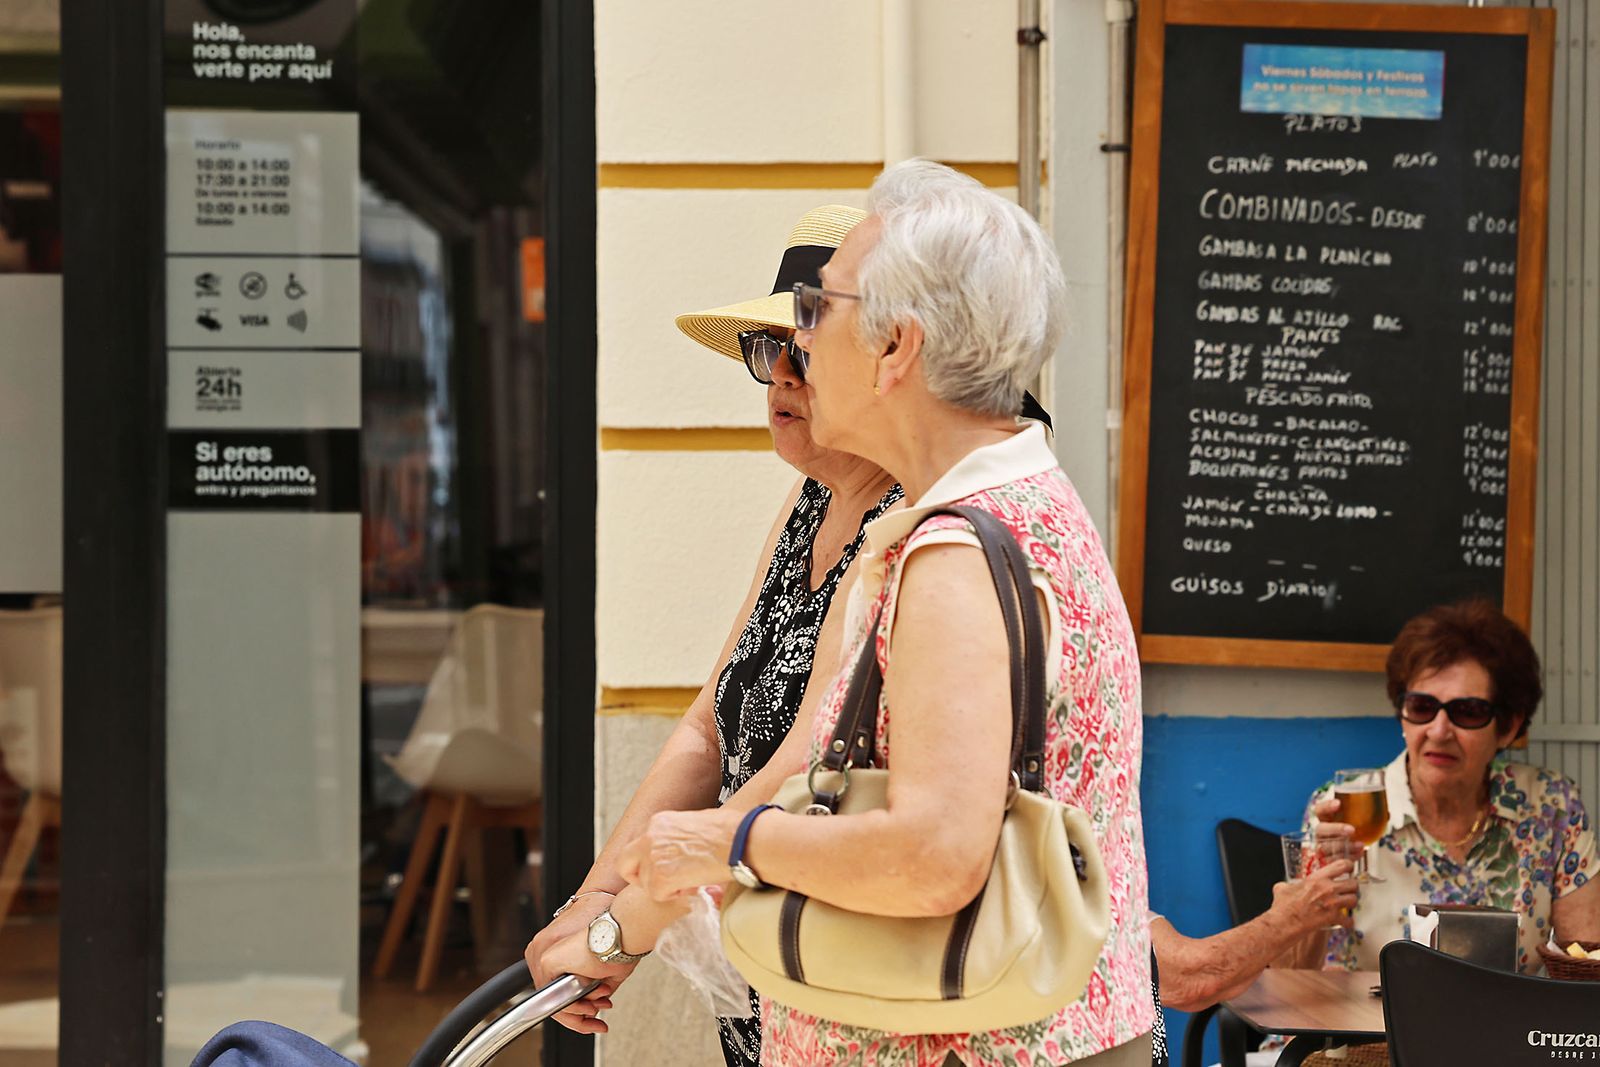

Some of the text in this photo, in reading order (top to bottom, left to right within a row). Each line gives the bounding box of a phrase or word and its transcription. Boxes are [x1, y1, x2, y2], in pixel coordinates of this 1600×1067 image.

[193, 22, 245, 42] Hola,
[193, 42, 316, 60] nos encanta
[193, 59, 333, 83] verte por aquí
[1262, 65, 1306, 79] Viernes
[1366, 71, 1374, 82] y
[1253, 81, 1269, 92] no
[1273, 83, 1286, 92] se
[1327, 83, 1363, 97] tapas
[1366, 87, 1381, 97] en
[1284, 113, 1363, 135] PLATOS
[197, 158, 290, 171] 10:00 a 14:00
[1208, 153, 1273, 173] CARNE
[1286, 156, 1368, 175] MECHADA
[1393, 152, 1438, 168] PLATO
[197, 173, 290, 187] 17:30 a 21:00
[197, 202, 290, 215] 10:00 a 14:00
[1371, 206, 1425, 230] DESDE
[1199, 234, 1263, 259] GAMBAS
[1265, 243, 1277, 260] A
[1285, 245, 1307, 263] LA
[1320, 246, 1392, 266] PLANCHA
[1198, 270, 1262, 292] GAMBAS
[240, 314, 269, 326] VISA
[1196, 300, 1260, 323] GAMBAS
[1267, 307, 1285, 325] AL
[1293, 309, 1350, 328] AJILLO
[1280, 325, 1341, 346] PANES
[1194, 338, 1226, 355] PAN
[1194, 355, 1225, 369] PAN
[1193, 366, 1223, 382] PAN
[196, 377, 242, 397] 24h
[1246, 388, 1324, 406] PESCADO
[1189, 408, 1259, 428] CHOCOS
[196, 441, 272, 462] Si eres
[196, 460, 316, 484] autónomo,
[195, 485, 228, 496] entra
[230, 486, 237, 498] y
[1336, 503, 1377, 519] LOMO
[1182, 537, 1232, 553] QUESO
[1170, 573, 1244, 595] GUISOS
[1527, 1030, 1600, 1048] Cruzca
